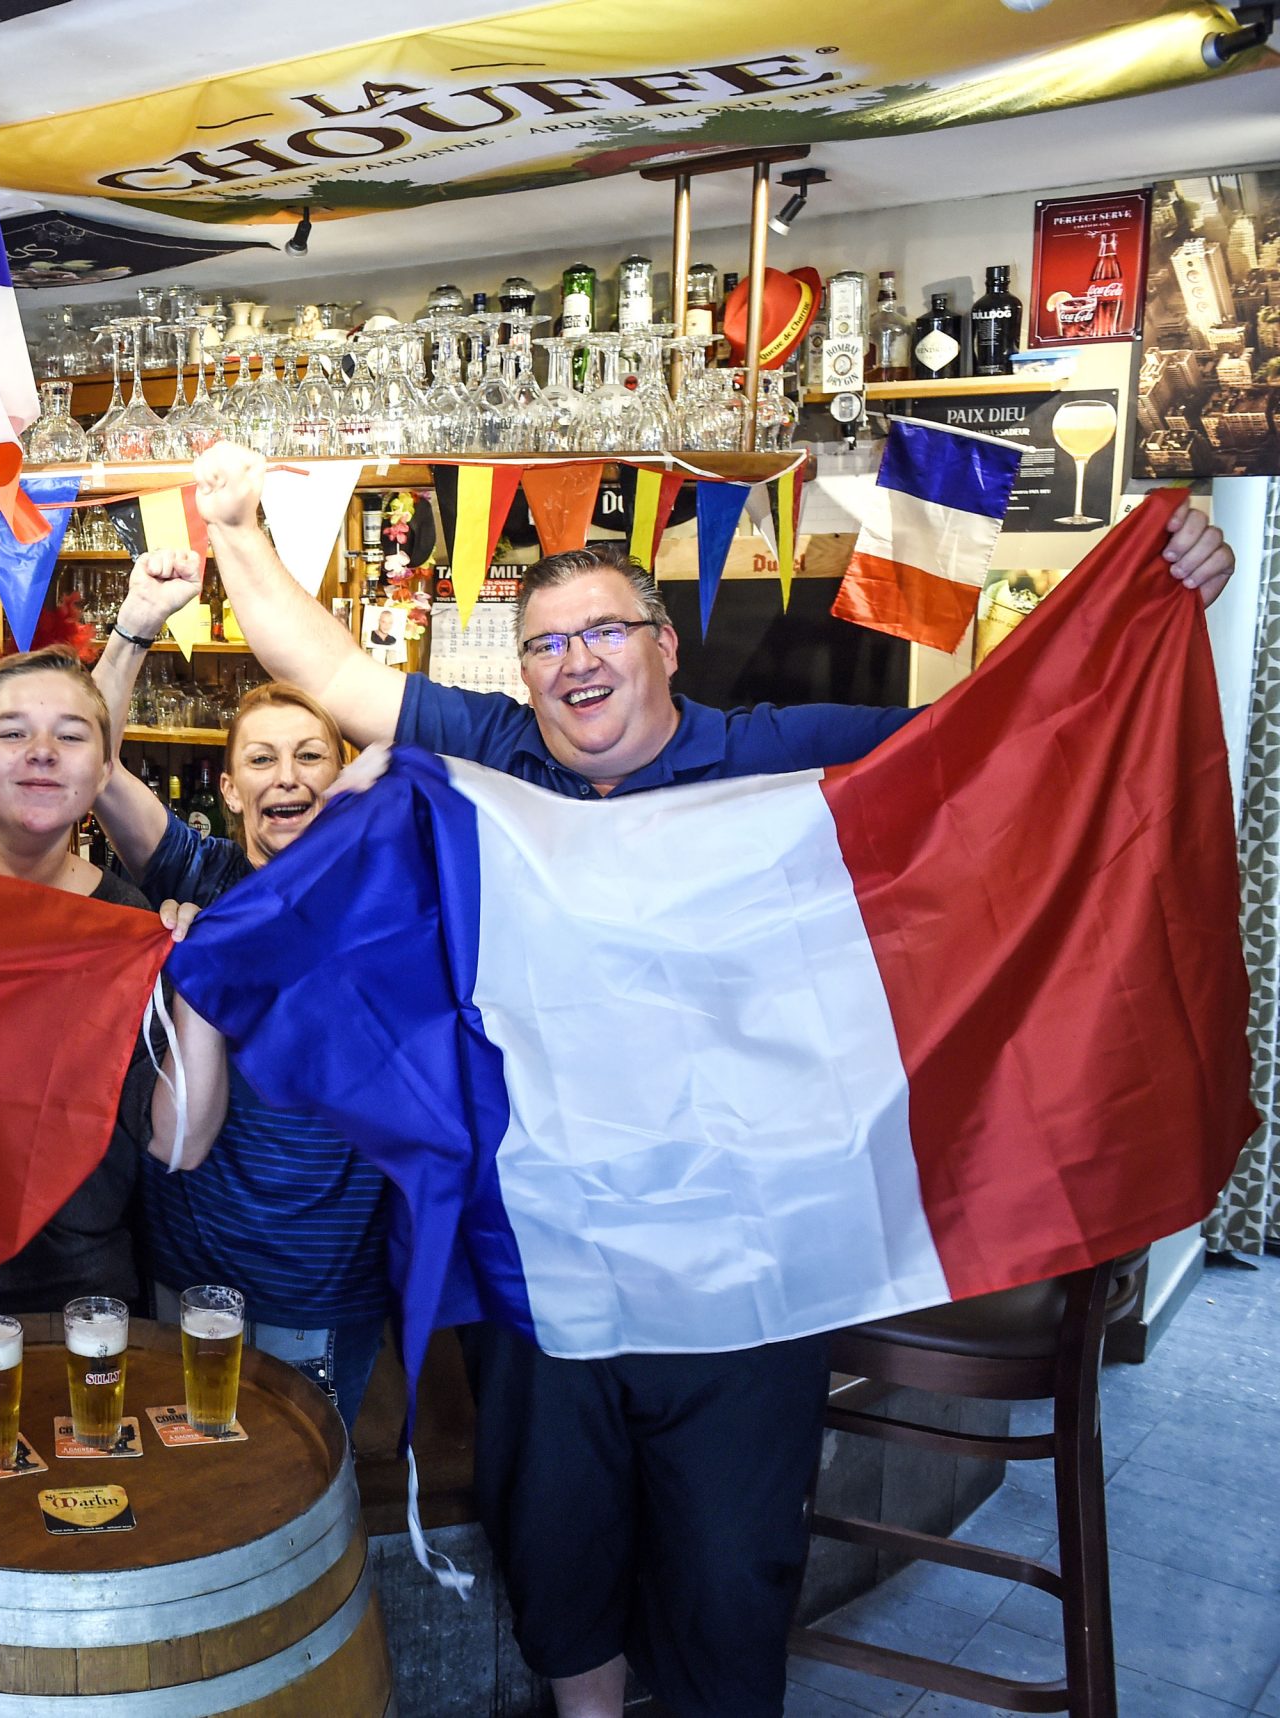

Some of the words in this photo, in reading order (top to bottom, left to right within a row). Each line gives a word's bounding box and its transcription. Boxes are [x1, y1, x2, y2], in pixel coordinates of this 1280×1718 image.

[290, 81, 431, 118] LA
[97, 55, 842, 191] CHOUFFE
[231, 171, 323, 194] BLONDE
[339, 137, 496, 174] D'ARDENNE
[657, 100, 773, 118] BLOND
[791, 82, 871, 101] BIER
[1053, 213, 1097, 226] PERFECT
[972, 309, 1012, 320] BULLDOG
[760, 341, 784, 360] Queue
[783, 332, 793, 342] de
[844, 373, 859, 385] GIN
[946, 408, 985, 424] PAIX
[988, 407, 1026, 423] DIEU
[752, 553, 806, 572] Duel
[85, 1369, 122, 1386] SILLY
[52, 1494, 120, 1511] Martin
